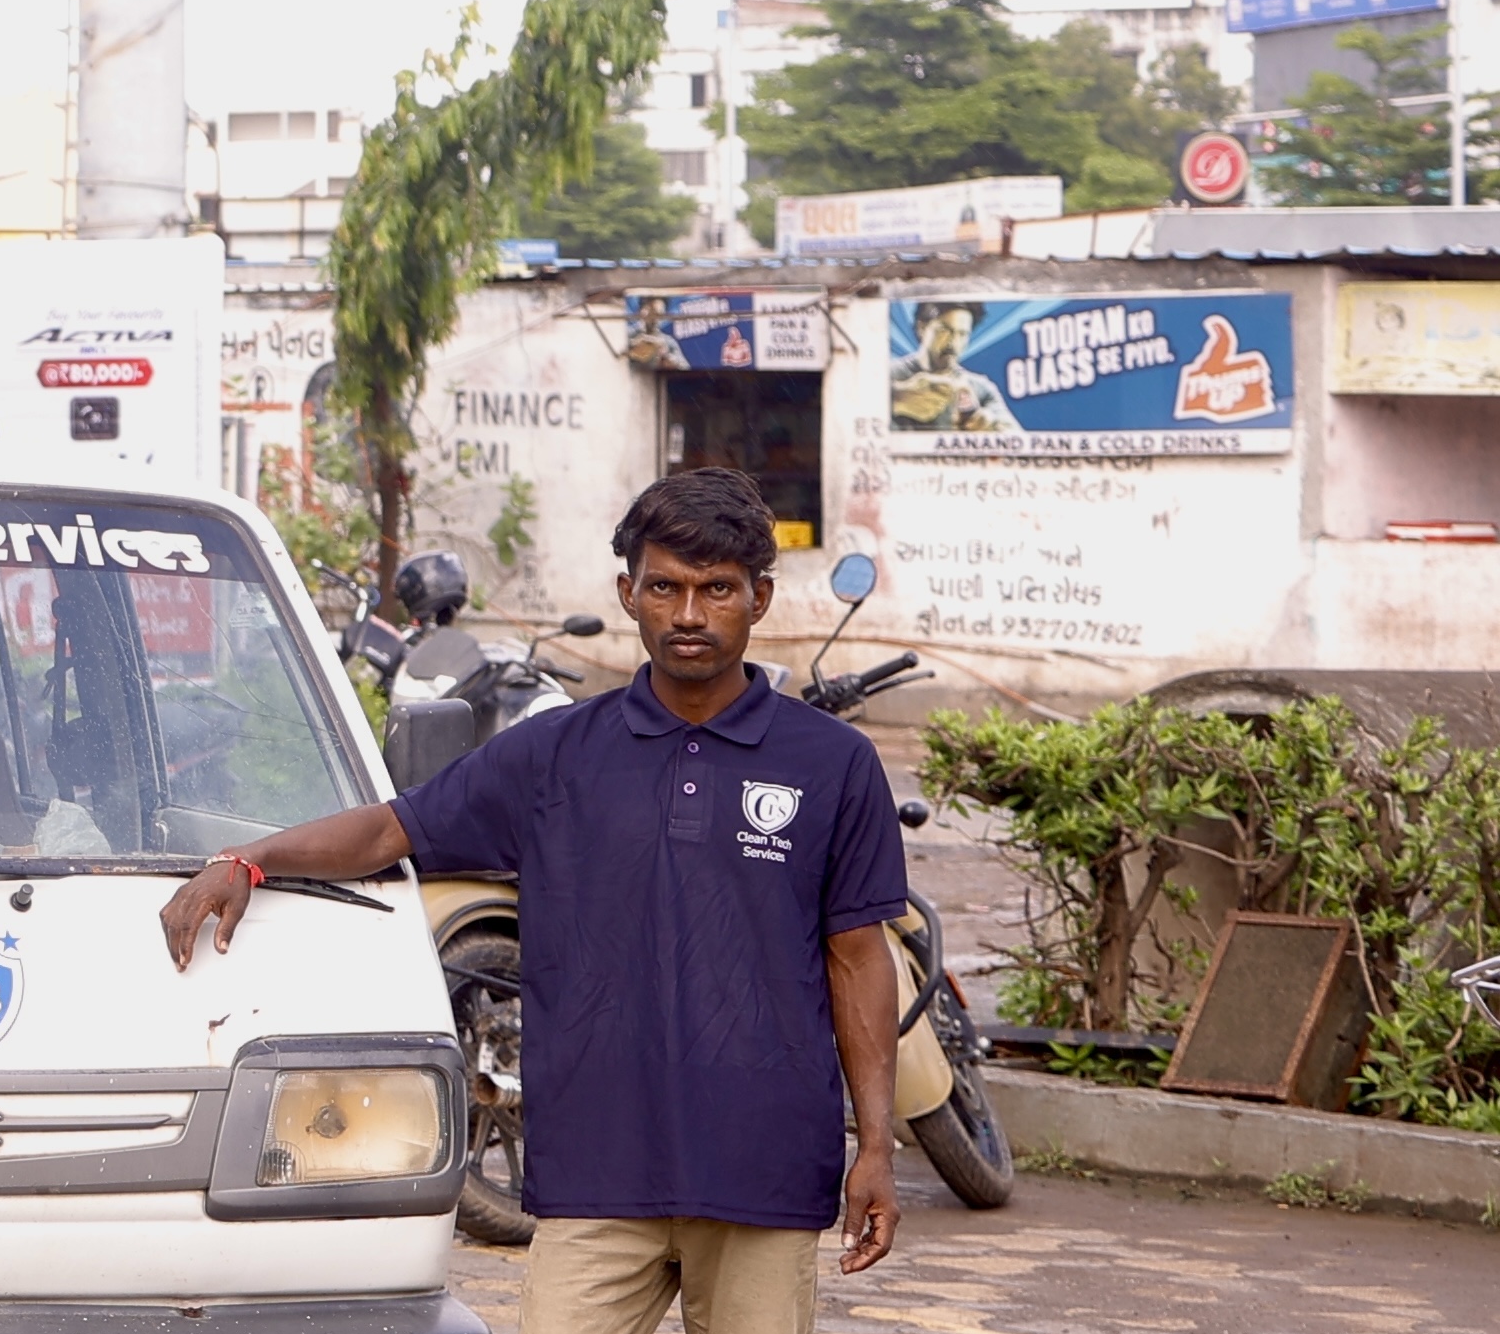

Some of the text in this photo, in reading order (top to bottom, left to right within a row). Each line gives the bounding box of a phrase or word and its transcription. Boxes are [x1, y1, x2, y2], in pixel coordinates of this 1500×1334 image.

[1022, 305, 1155, 358] TOOFAN KO
[1006, 350, 1097, 399] GLASS
[1099, 346, 1123, 375] SE
[455, 389, 585, 430] FINANCE
[934, 433, 1242, 452] AANAND PAN & COLD DRINKS
[736, 831, 793, 851] Clean Tech
[742, 845, 787, 863] Services
